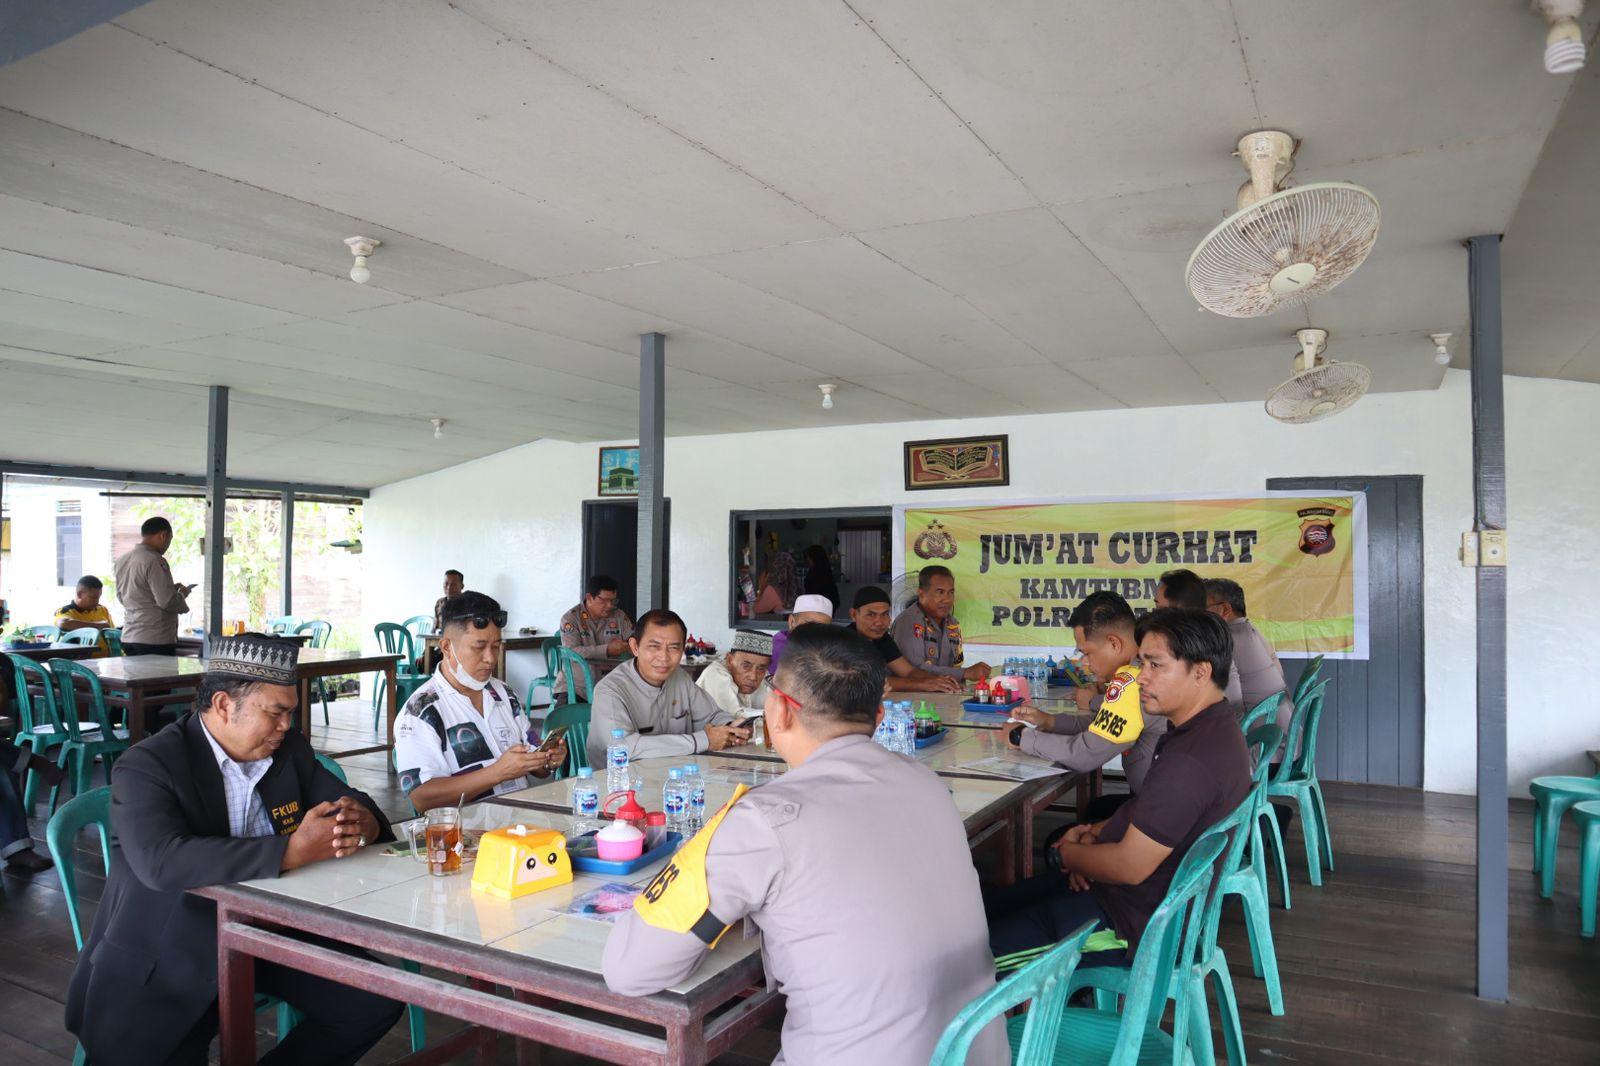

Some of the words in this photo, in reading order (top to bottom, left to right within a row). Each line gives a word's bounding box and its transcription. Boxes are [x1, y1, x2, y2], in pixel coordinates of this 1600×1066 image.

[980, 532, 1099, 573] JUM'AT
[1108, 530, 1257, 564] CURHAT
[1020, 578, 1162, 600] KAMTIBM
[992, 605, 1078, 628] POLR
[1107, 714, 1127, 738] RES
[271, 801, 299, 819] FKUB
[642, 861, 680, 904] ES
